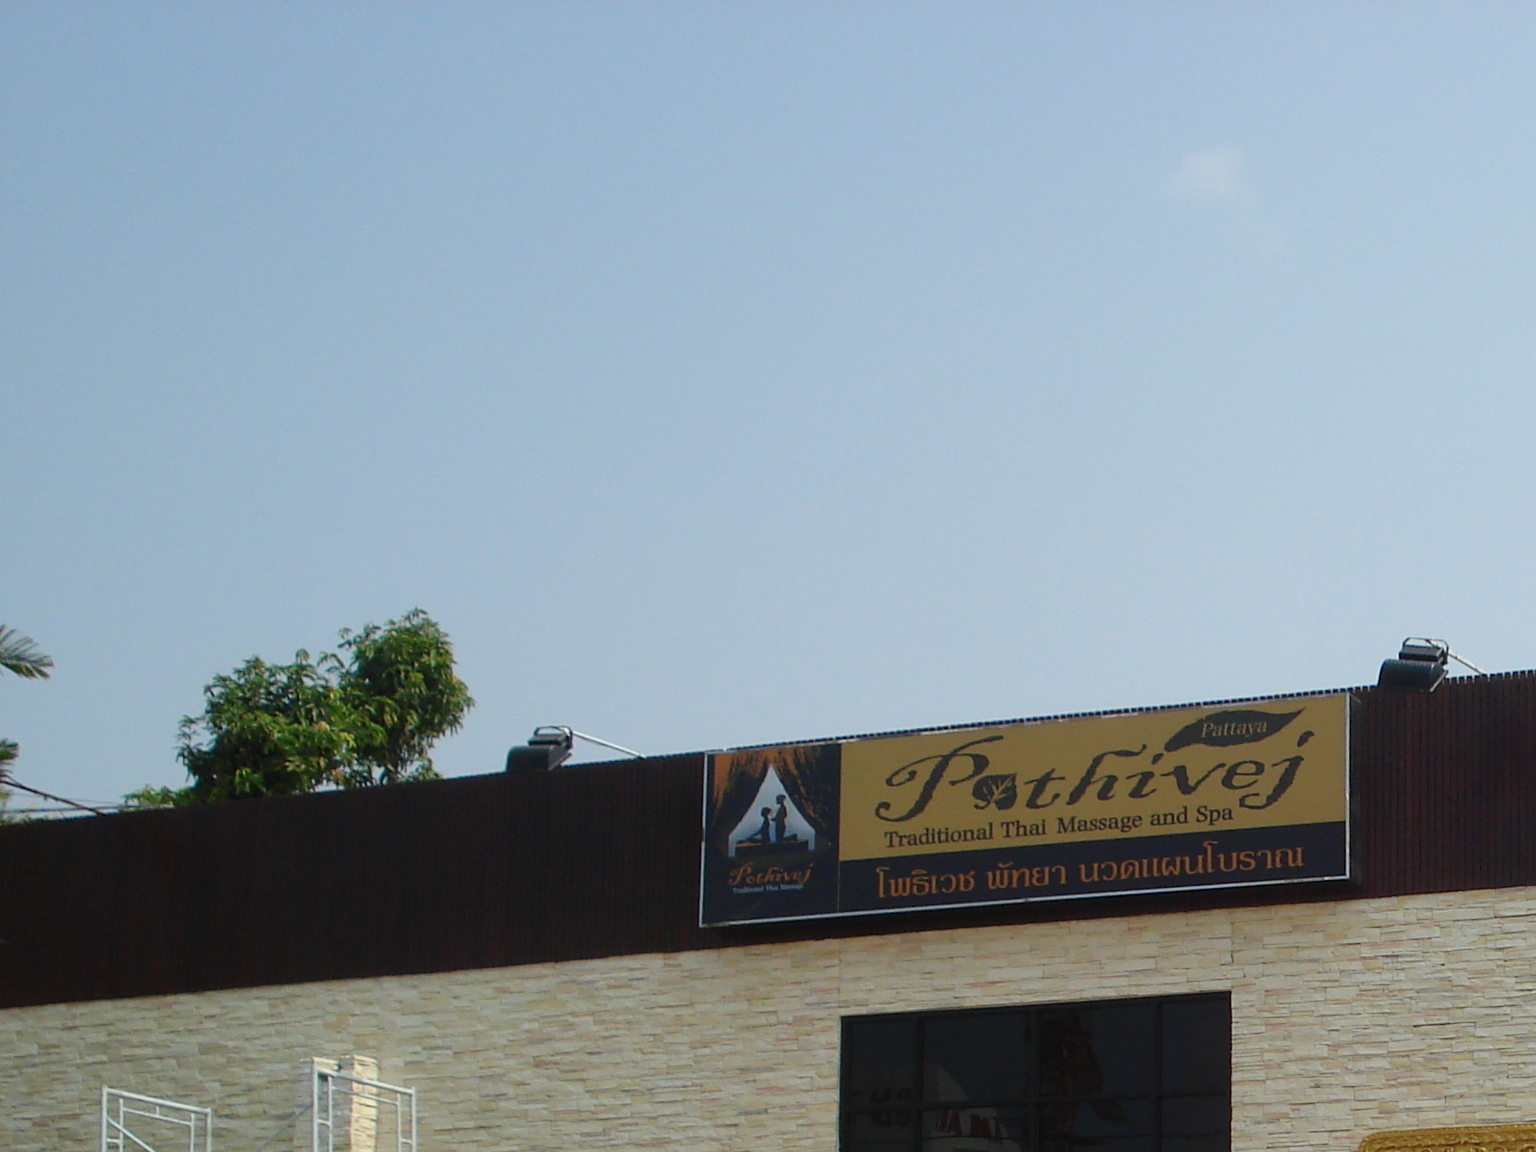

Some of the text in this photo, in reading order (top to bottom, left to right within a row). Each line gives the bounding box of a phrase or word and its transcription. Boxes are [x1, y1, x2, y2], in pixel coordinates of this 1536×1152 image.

[1201, 721, 1268, 739] Pattaya
[884, 805, 1234, 848] Traditional Thai Massage and Spa
[876, 840, 1304, 898] โพธิเวช พัทยา นวดแผนโบราณ
